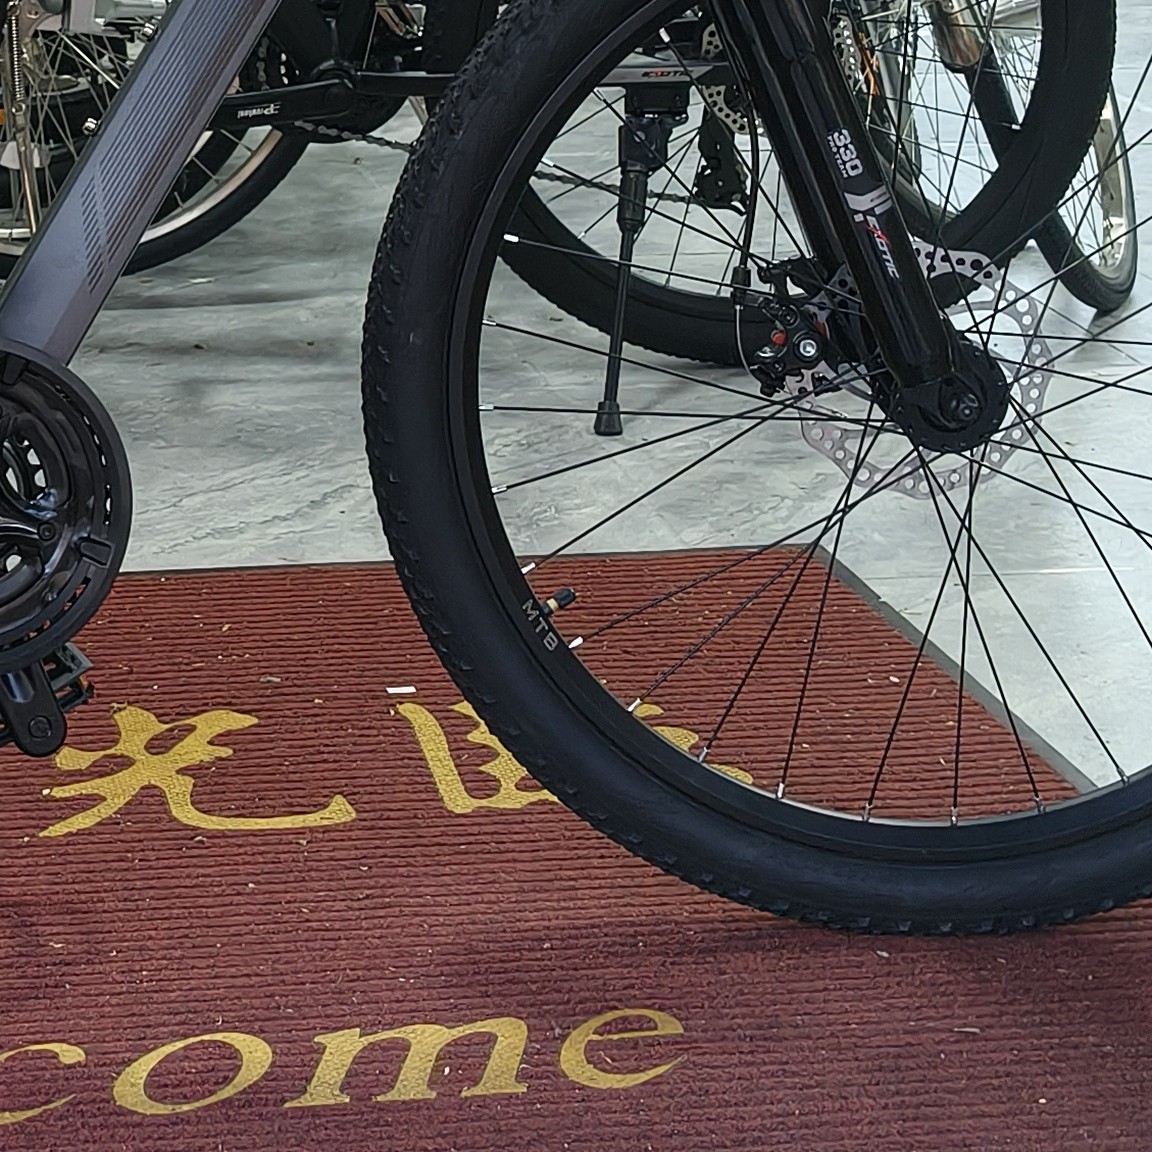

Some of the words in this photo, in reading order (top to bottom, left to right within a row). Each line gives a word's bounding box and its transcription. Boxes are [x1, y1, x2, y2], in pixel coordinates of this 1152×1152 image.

[833, 129, 863, 177] 330
[834, 154, 848, 178] TEAM
[866, 215, 899, 279] EXOTIC
[522, 599, 558, 651] MTB
